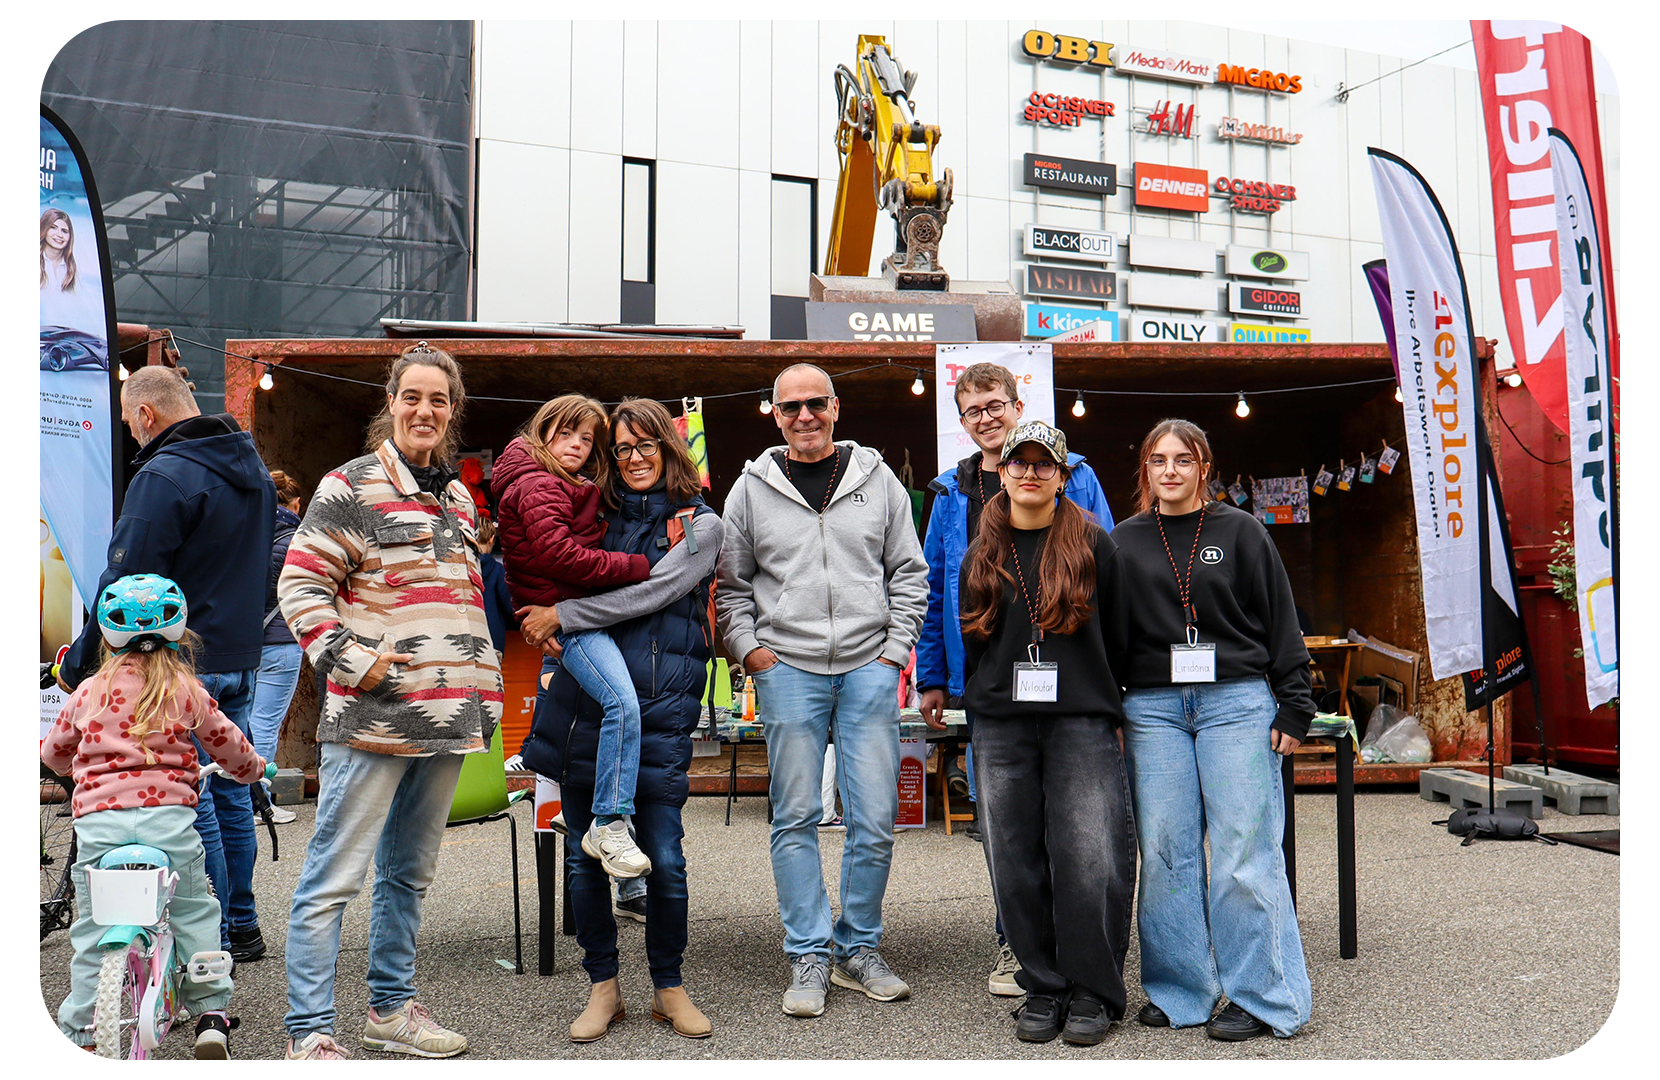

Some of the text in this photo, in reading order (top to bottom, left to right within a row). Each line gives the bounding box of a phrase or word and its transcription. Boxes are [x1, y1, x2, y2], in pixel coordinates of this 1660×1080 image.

[1022, 29, 1114, 67] OBI
[1124, 51, 1210, 77] Media Markt
[1218, 63, 1302, 94] MIGROS
[1029, 90, 1115, 117] OCHSNER
[1024, 105, 1085, 127] SPORT
[1148, 99, 1195, 139] H&M
[1243, 122, 1303, 144] Müller
[1034, 159, 1062, 170] MIGROS
[1034, 168, 1109, 188] RESTAURANT
[1139, 177, 1207, 198] DENNER
[1216, 176, 1297, 201] OCHSNER
[1233, 195, 1281, 212] SHOES
[1033, 270, 1112, 295] VISILAB
[1251, 289, 1299, 306] GIDOR
[1263, 303, 1300, 314] COIFFURE
[1405, 289, 1417, 330] Ihre
[849, 312, 935, 333] GAME
[1053, 312, 1100, 332] kio
[1142, 320, 1206, 342] ONLY
[1431, 290, 1467, 539] nexplore
[1203, 549, 1219, 561] n
[1174, 659, 1211, 674] Liridona
[42, 694, 61, 704] UPSA
